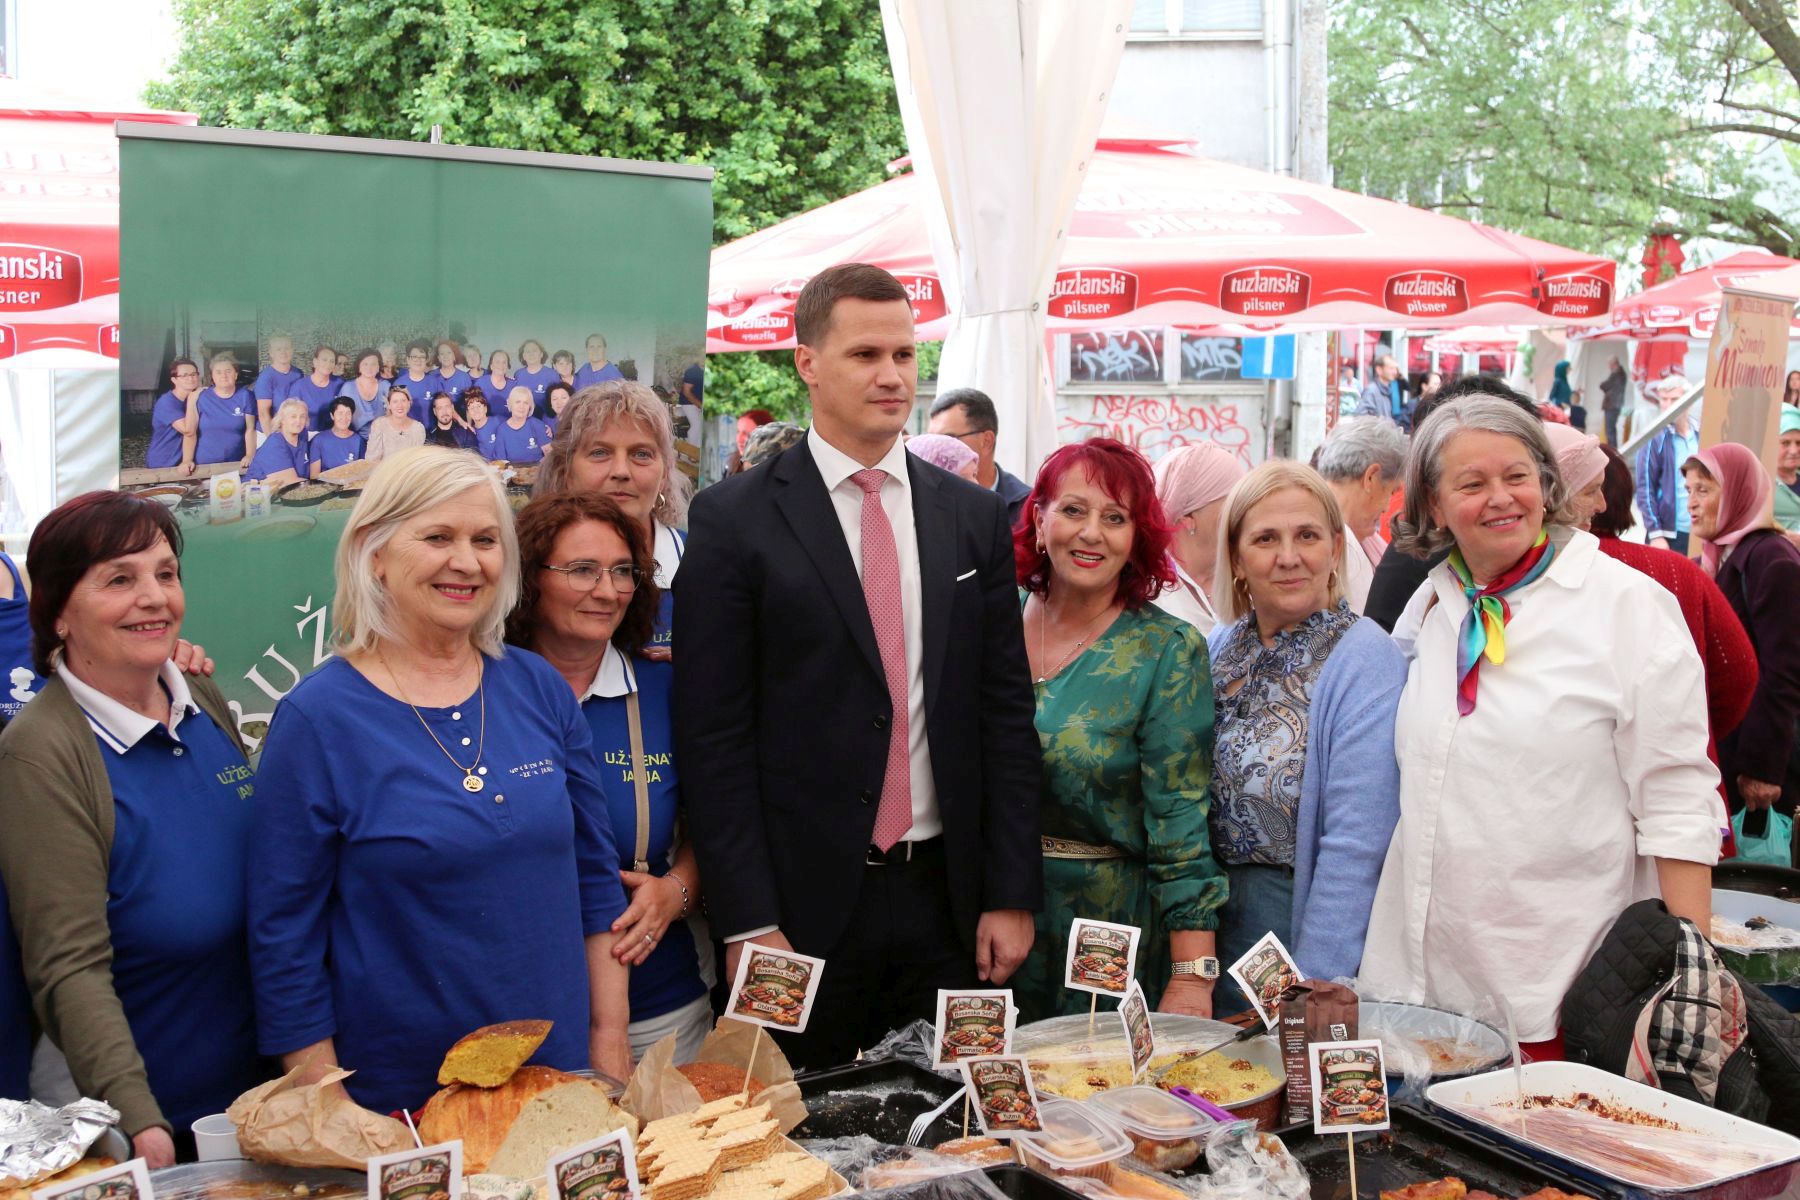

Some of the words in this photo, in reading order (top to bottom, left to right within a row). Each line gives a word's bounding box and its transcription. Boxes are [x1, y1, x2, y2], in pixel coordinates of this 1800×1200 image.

[1231, 270, 1300, 294] tuzlanski
[1393, 273, 1457, 297] tuzlanski
[1064, 300, 1110, 317] pilsner
[1243, 297, 1285, 315] pilsner
[1407, 300, 1447, 315] pilsner
[1552, 301, 1588, 315] pilsner
[622, 769, 662, 784] JAJA
[784, 972, 800, 981] Sofra
[954, 1009, 981, 1017] Bosanska
[981, 1010, 997, 1018] Sofra
[1284, 1017, 1305, 1026] Original
